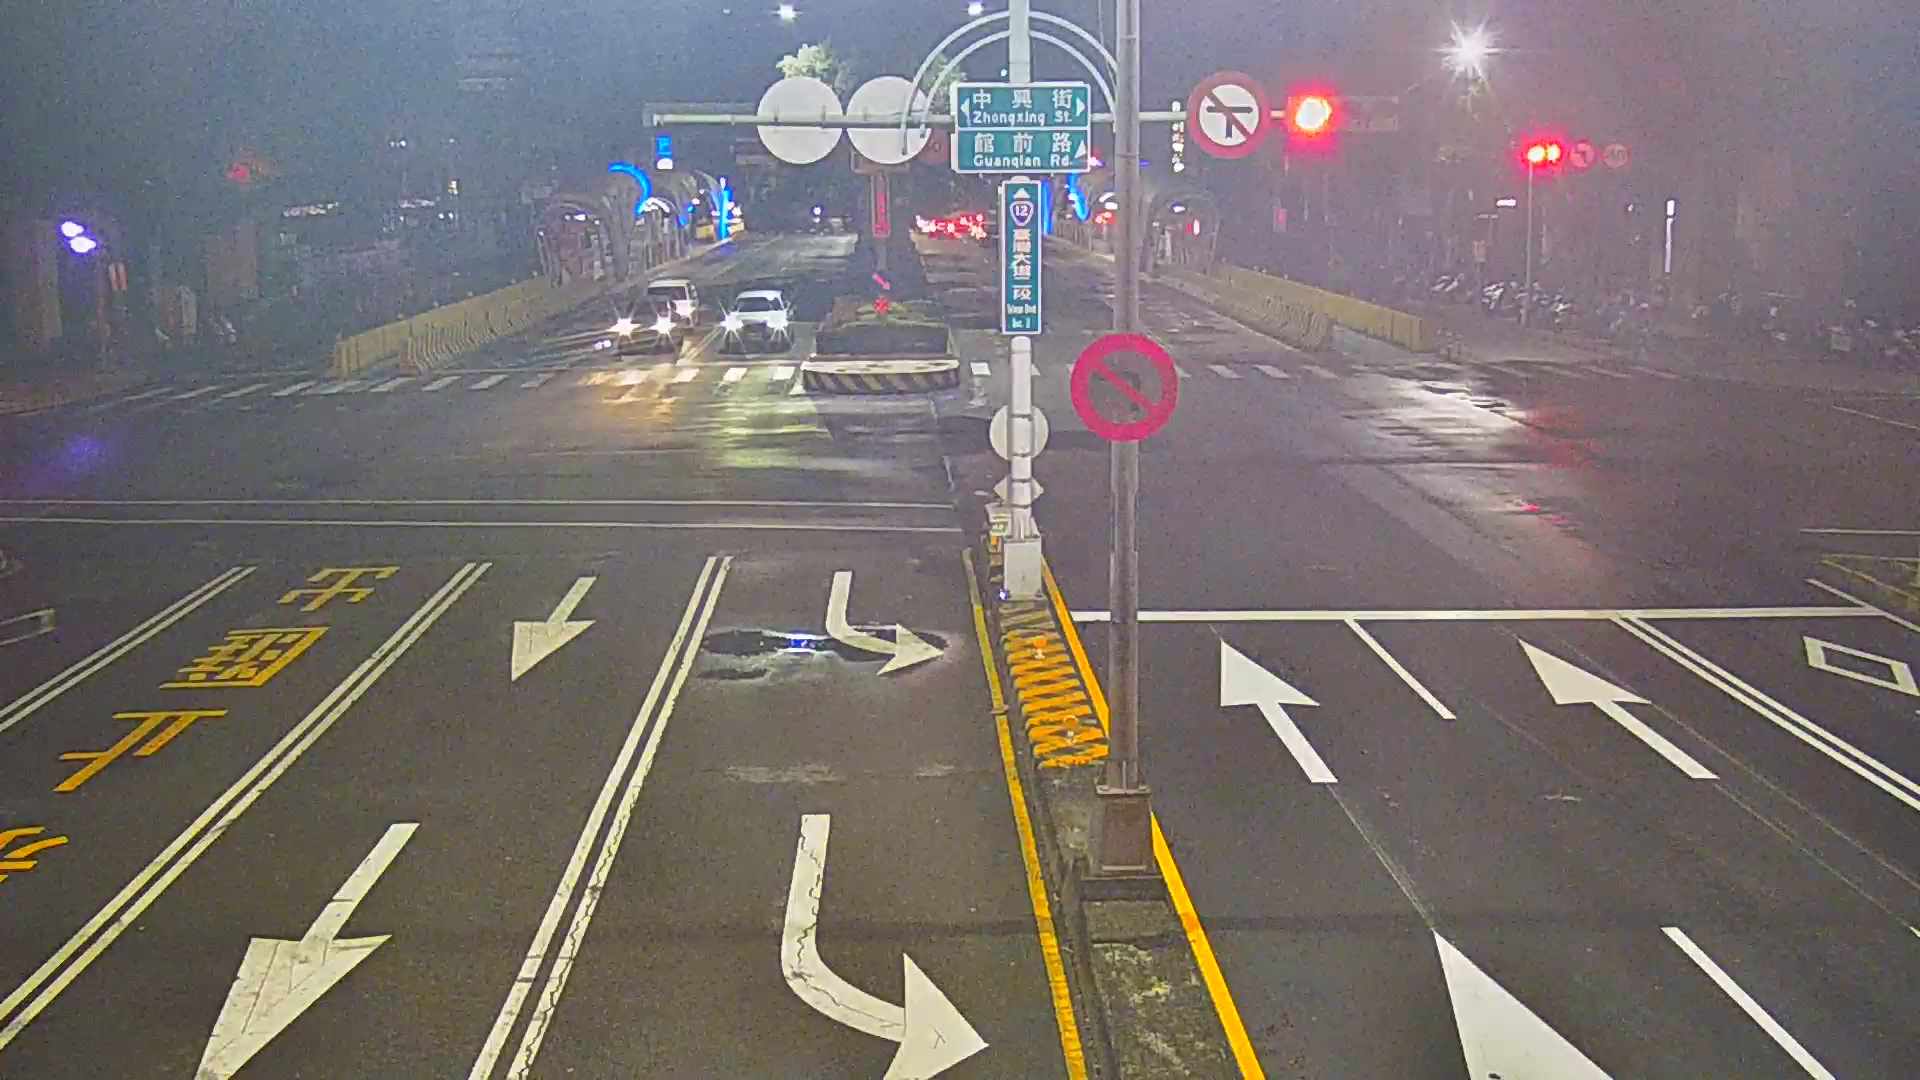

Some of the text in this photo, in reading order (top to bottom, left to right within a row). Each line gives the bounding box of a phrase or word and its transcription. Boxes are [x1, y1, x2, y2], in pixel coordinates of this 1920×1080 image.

[973, 88, 1072, 109] 中興街
[972, 110, 1046, 126] Zhongxing
[974, 132, 1073, 153] 館前路
[974, 154, 1041, 168] Guanqian
[1015, 205, 1028, 217] 12
